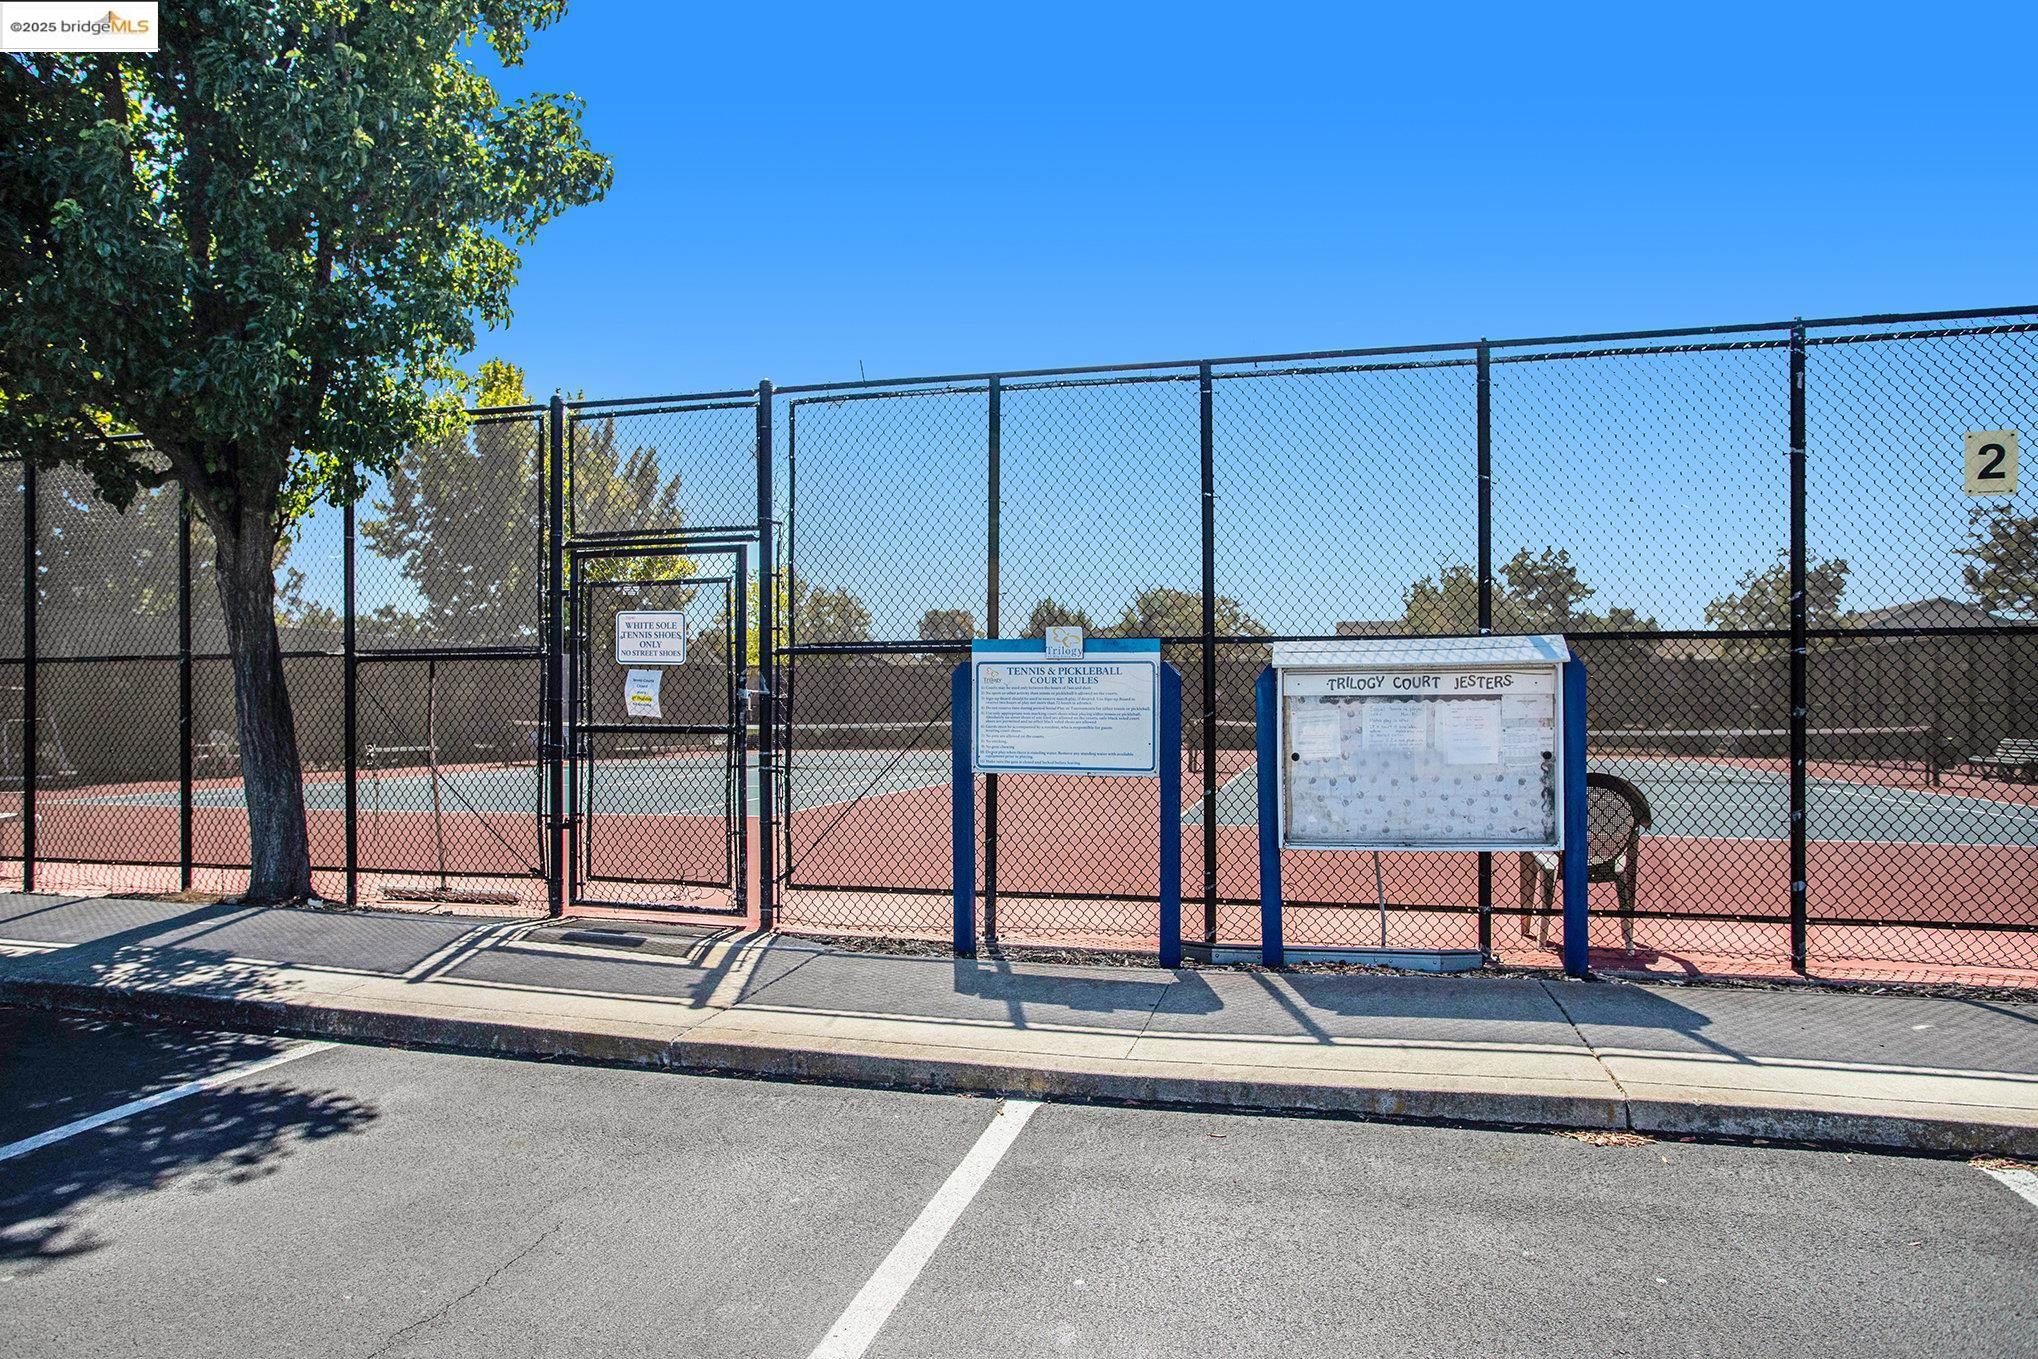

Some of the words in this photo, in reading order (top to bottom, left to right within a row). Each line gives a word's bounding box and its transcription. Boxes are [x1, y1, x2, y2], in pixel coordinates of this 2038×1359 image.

[1977, 443, 2006, 480] 2
[1047, 646, 1082, 658] Trilogy
[1006, 667, 1045, 675] TENNIS
[1048, 667, 1056, 675] &
[1058, 667, 1122, 676] PICKLEBALL
[1068, 676, 1099, 684] RULES
[1328, 676, 1386, 690] TRILOGY
[1392, 676, 1440, 690] COURT
[1454, 674, 1512, 690] JESTERS
